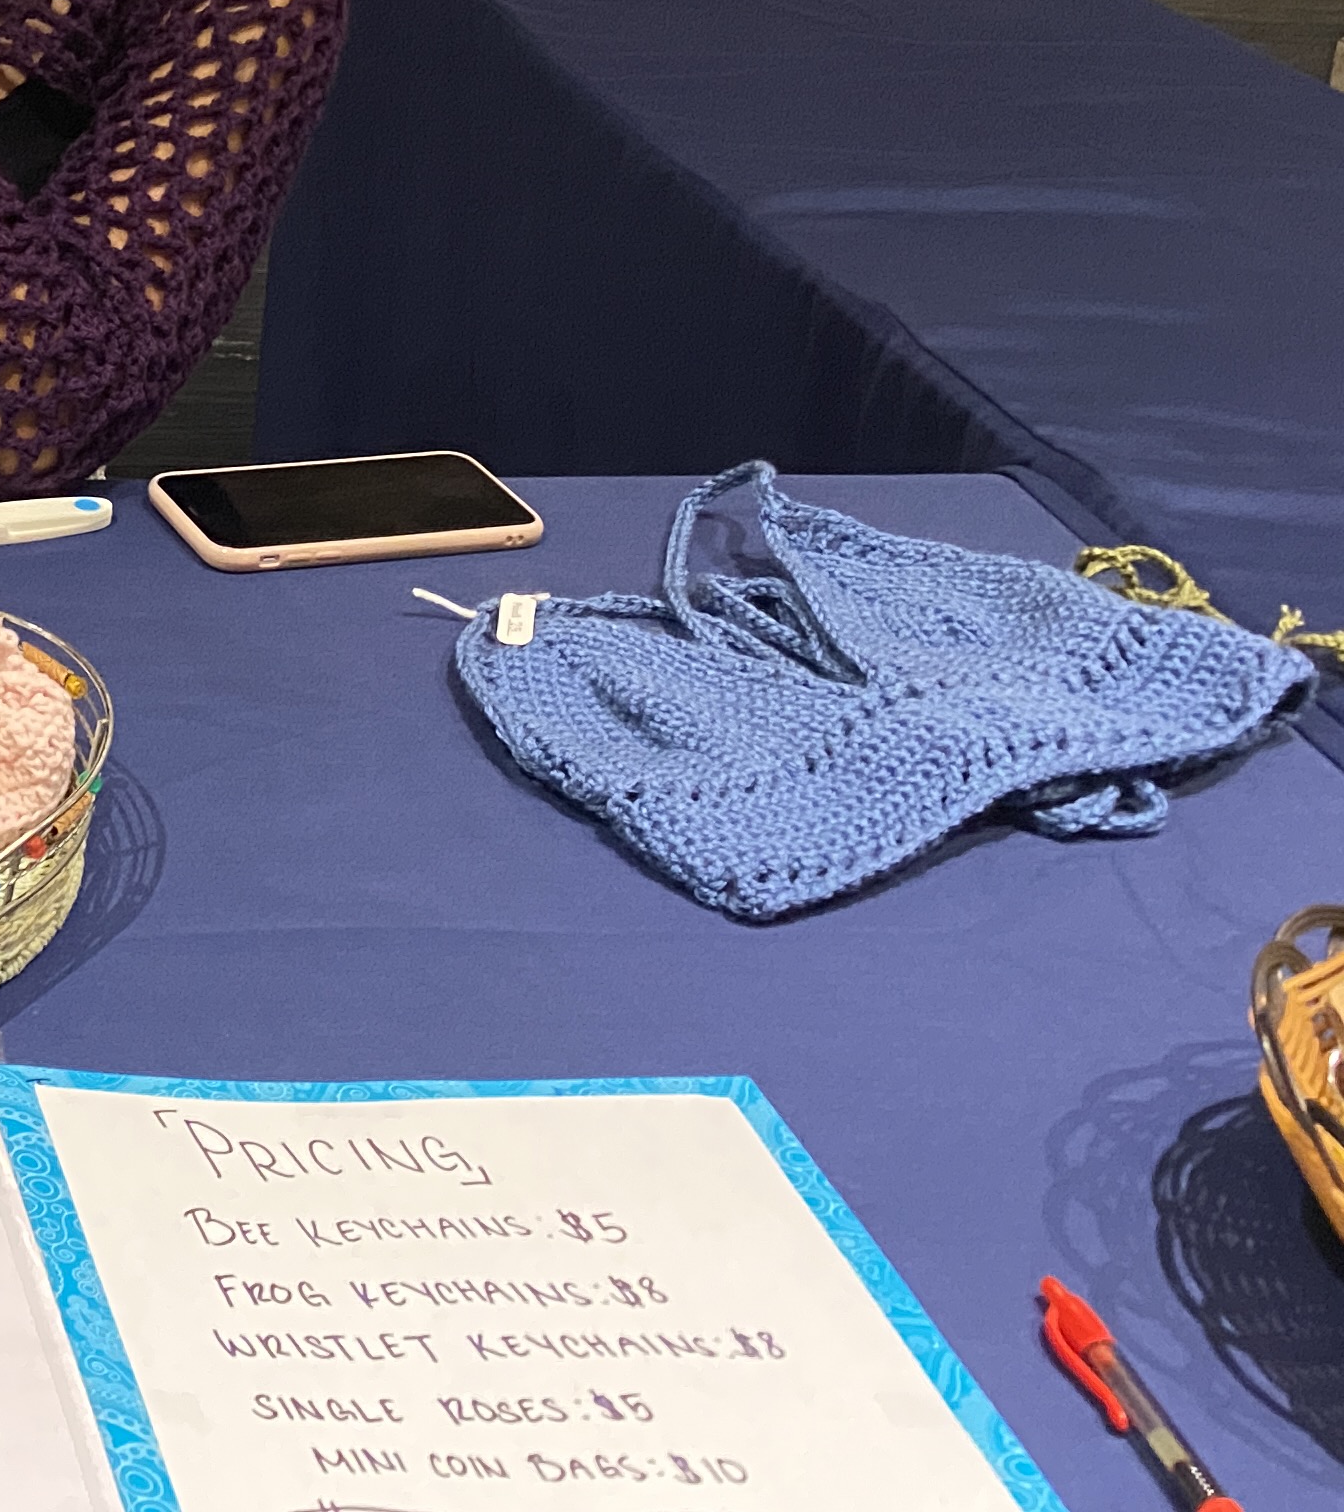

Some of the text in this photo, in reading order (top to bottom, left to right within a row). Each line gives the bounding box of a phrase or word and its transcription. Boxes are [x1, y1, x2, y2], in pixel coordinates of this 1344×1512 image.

[184, 1208, 279, 1246] BEE
[214, 1274, 332, 1308] FROG
[213, 1329, 438, 1363] WRISTLET
[252, 1394, 404, 1423] SINGLE
[311, 1447, 408, 1474] MINI
[429, 1453, 510, 1479] COIN
